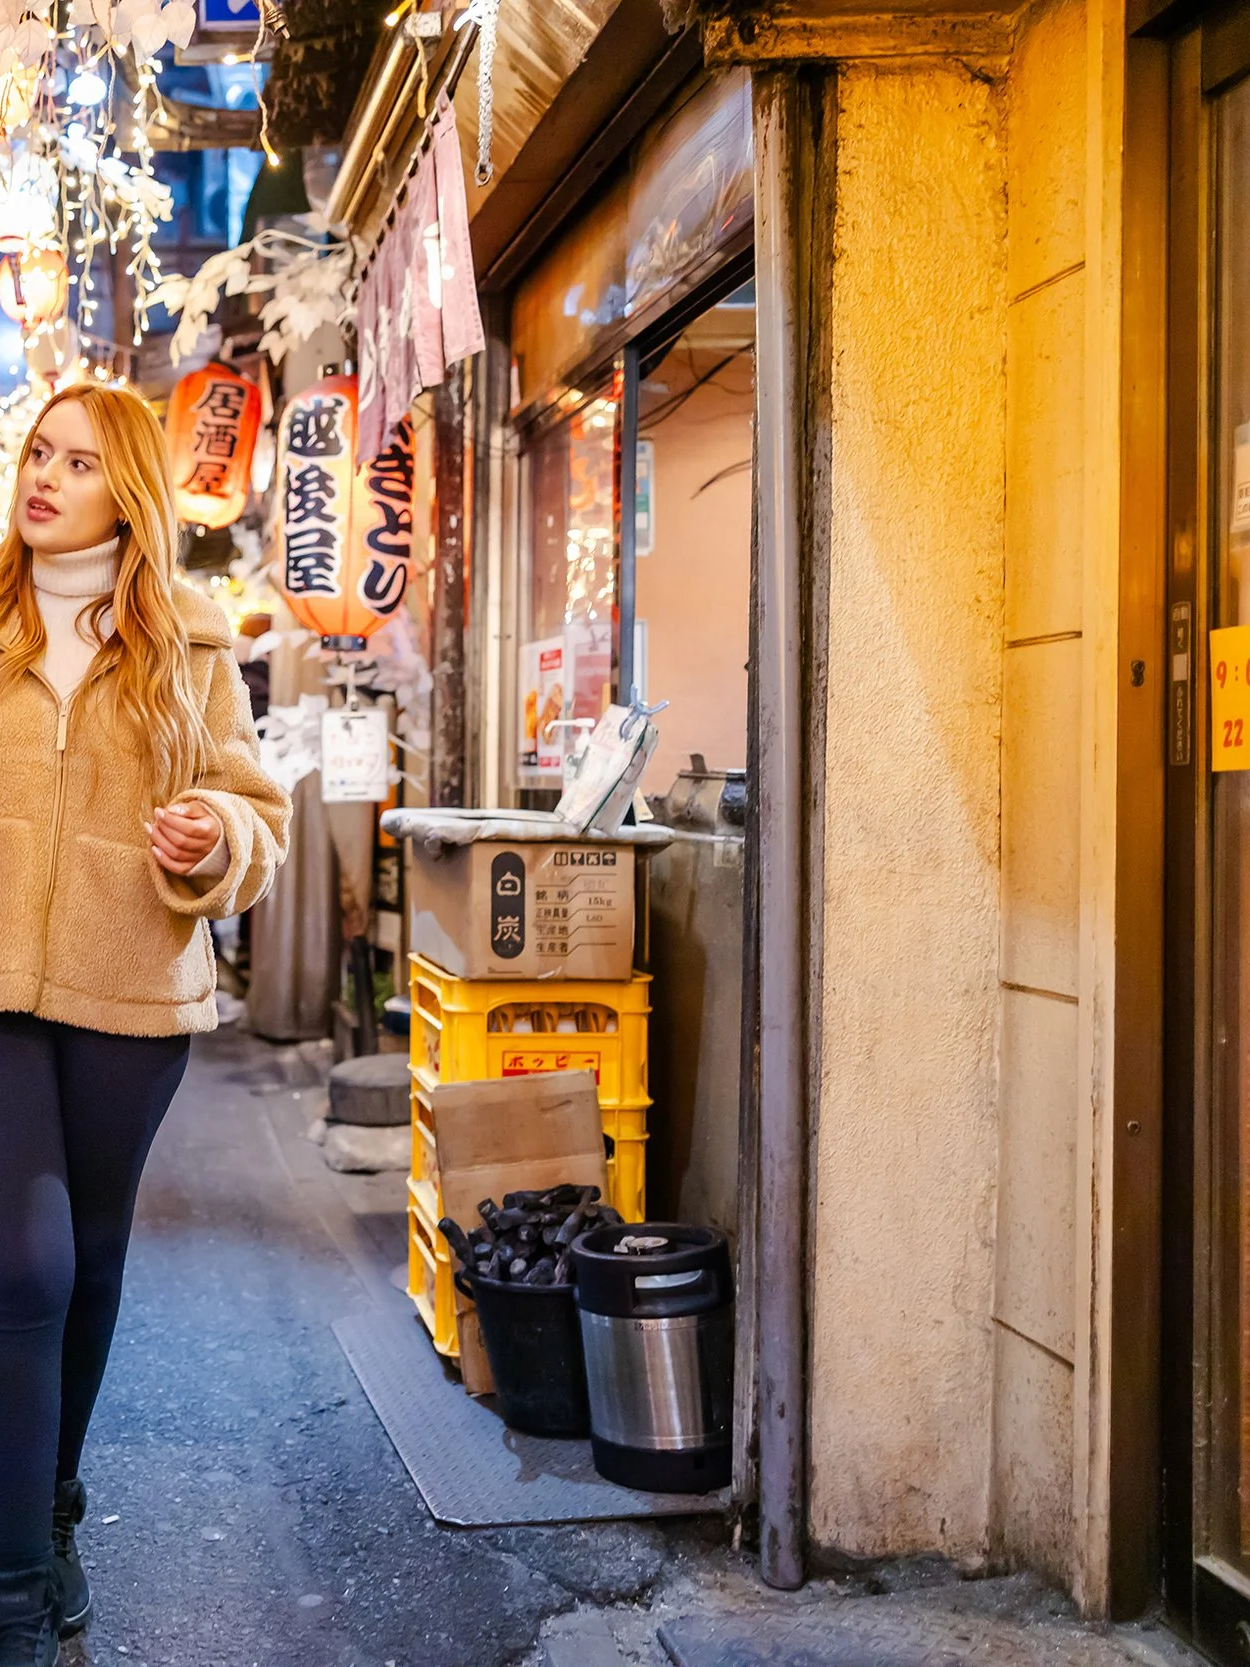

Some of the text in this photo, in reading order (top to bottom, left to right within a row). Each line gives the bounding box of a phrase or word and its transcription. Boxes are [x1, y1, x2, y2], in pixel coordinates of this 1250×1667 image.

[182, 383, 246, 498] 居酒屋
[285, 397, 345, 594] 越後屋
[1223, 718, 1244, 748] 22
[494, 871, 521, 940] 白炭
[588, 896, 613, 907] 15kg
[535, 942, 569, 953] 生産者
[507, 1055, 595, 1069] ホッピー
